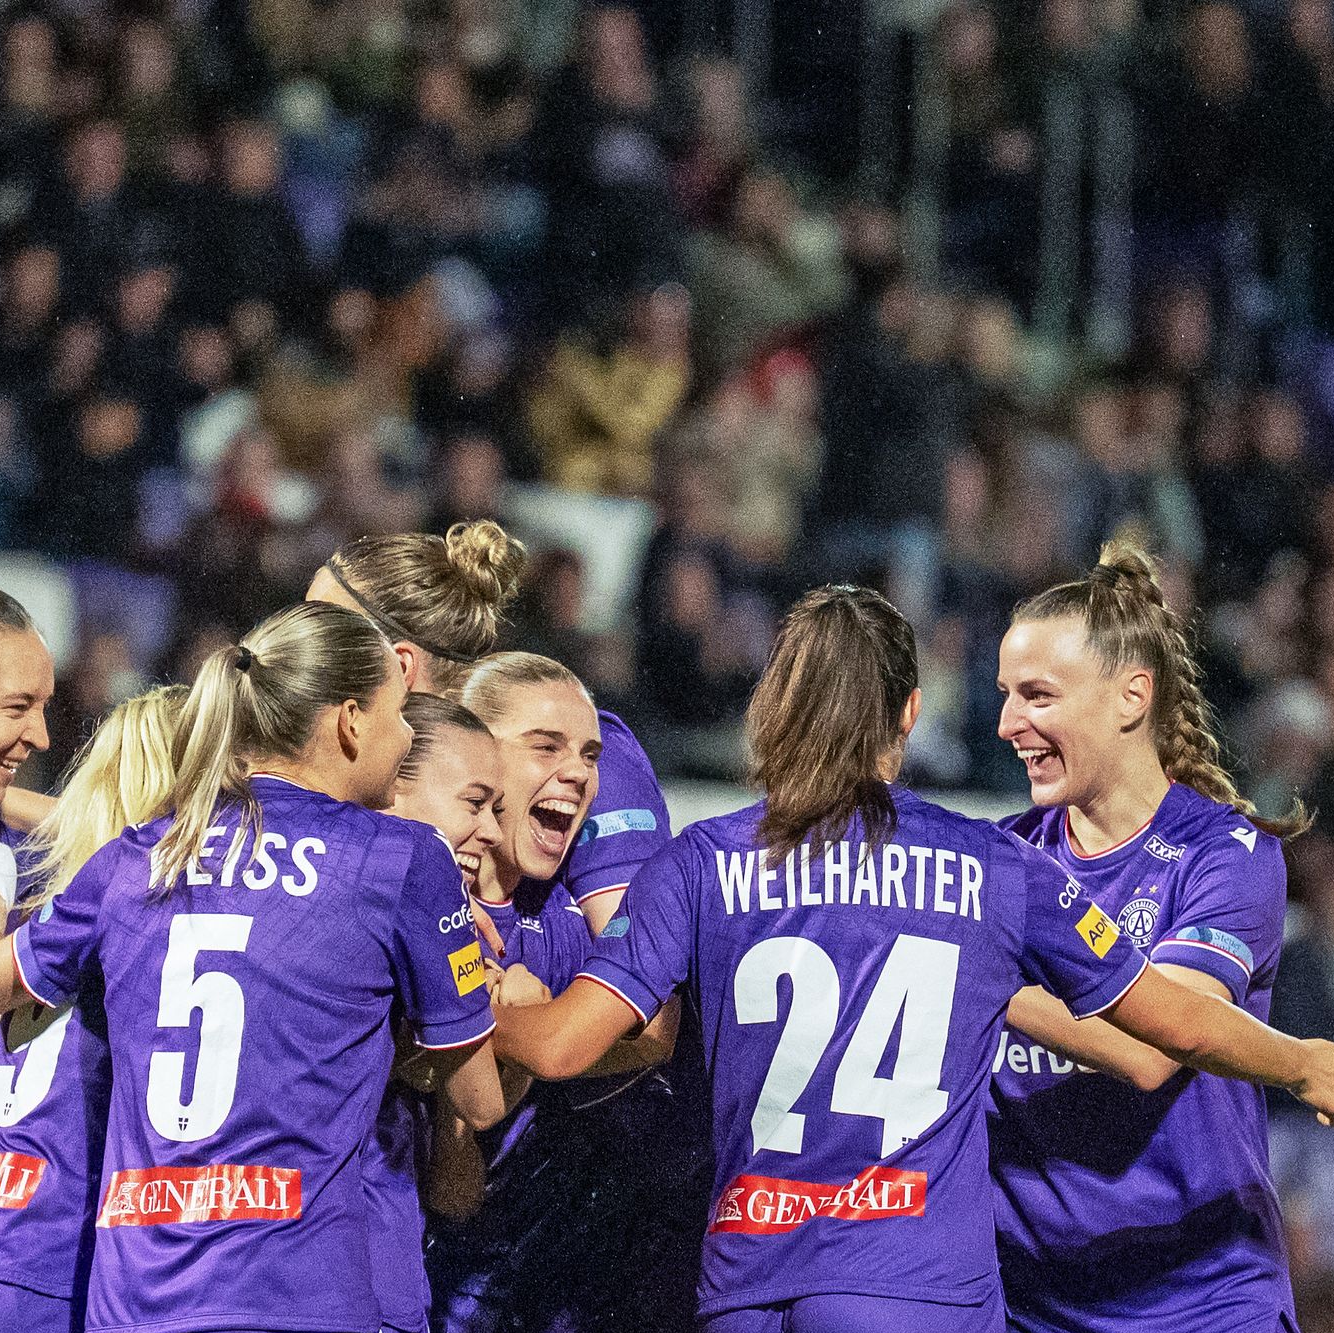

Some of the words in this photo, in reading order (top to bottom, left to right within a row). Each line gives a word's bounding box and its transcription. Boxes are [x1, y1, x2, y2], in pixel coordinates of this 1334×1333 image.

[716, 840, 983, 921] WEILHARTER
[146, 914, 254, 1143] 5
[734, 934, 961, 1160] 24
[138, 1178, 290, 1217] GENERALI
